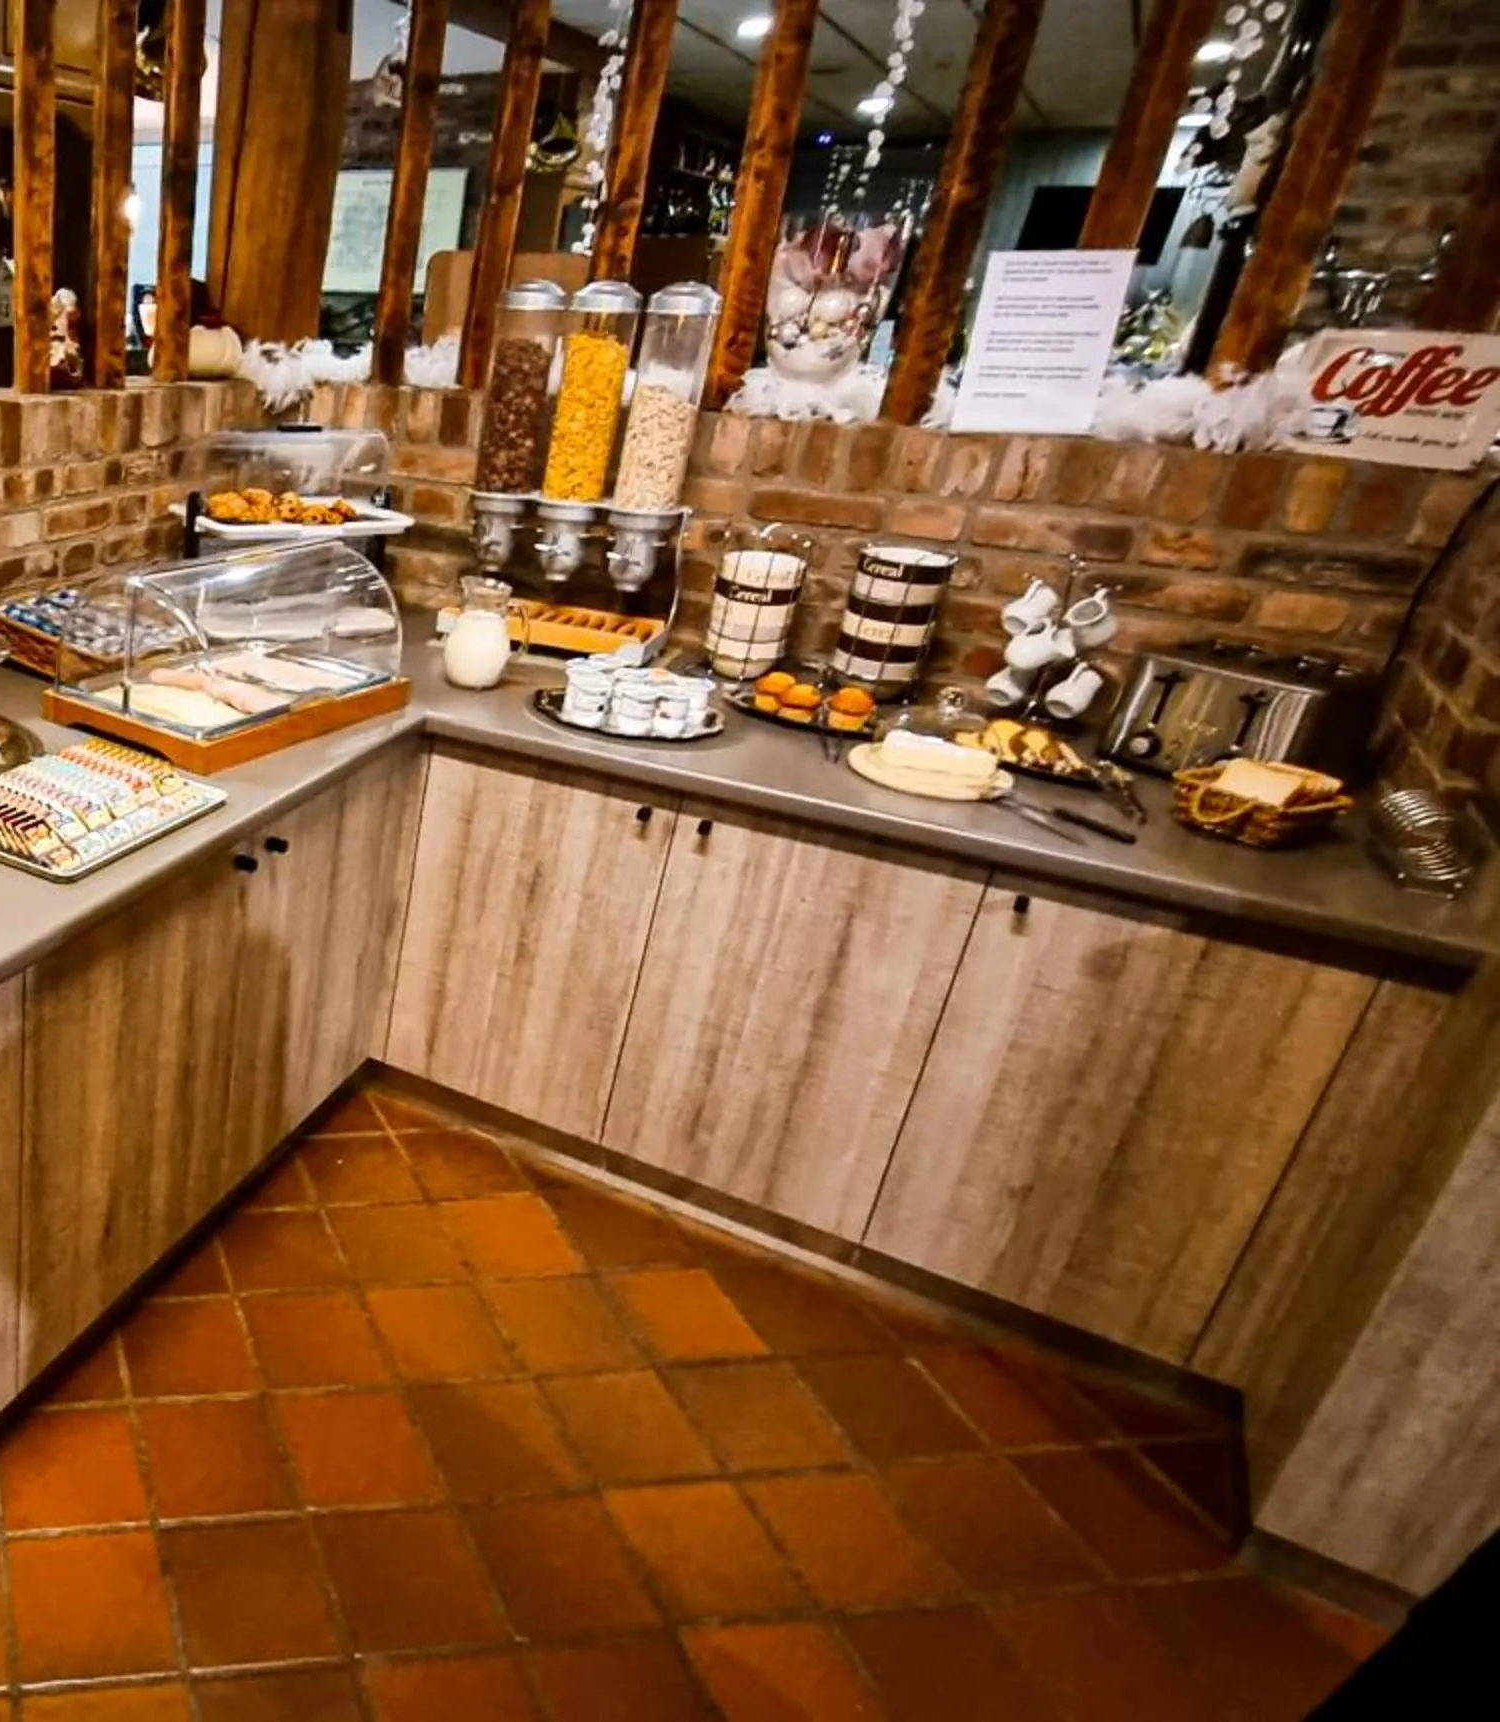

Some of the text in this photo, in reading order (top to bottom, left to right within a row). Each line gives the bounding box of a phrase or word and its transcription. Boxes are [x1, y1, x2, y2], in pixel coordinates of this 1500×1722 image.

[1311, 345, 1500, 418] Coffee
[863, 556, 905, 577] Cereal
[728, 584, 773, 603] Cereal
